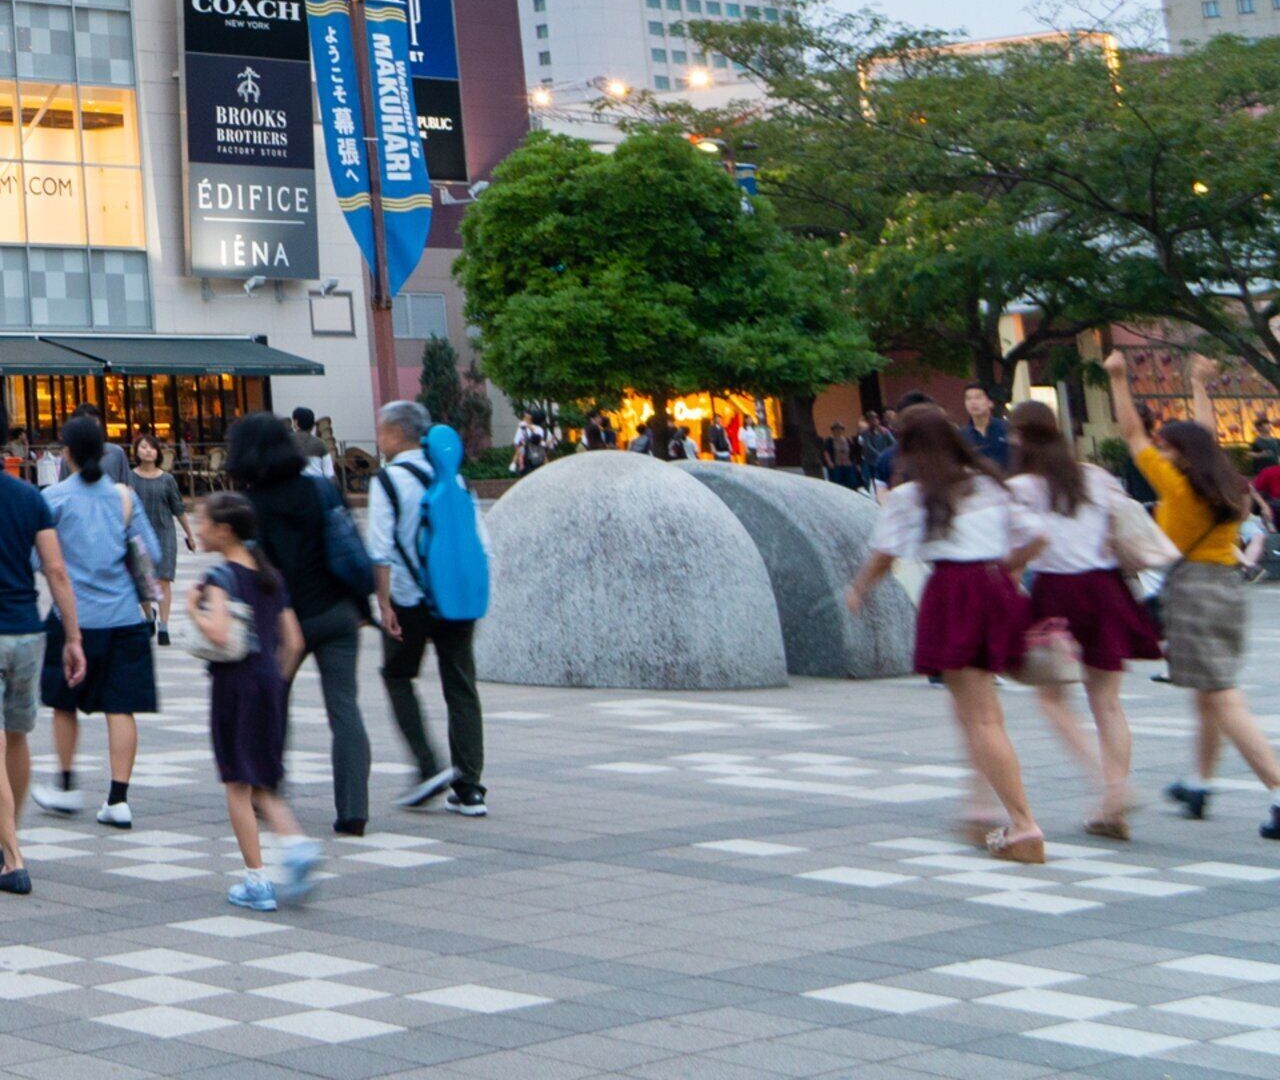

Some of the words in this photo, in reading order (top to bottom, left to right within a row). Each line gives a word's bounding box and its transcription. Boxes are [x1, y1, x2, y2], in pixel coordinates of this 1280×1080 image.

[224, 19, 245, 28] NEW
[247, 20, 271, 30] YORK
[216, 105, 287, 129] BROOKS
[324, 25, 360, 183] ようこそ幕張へ
[371, 33, 412, 181] MAKUHARI
[395, 60, 415, 136] Welcome
[410, 140, 420, 159] to
[216, 127, 288, 146] BROTHERS
[417, 115, 453, 131] PUBLIC
[217, 145, 255, 155] FACTORY
[261, 148, 288, 158] STORE
[198, 178, 309, 213] ÉDIFICE
[221, 234, 290, 267] IÉNA
